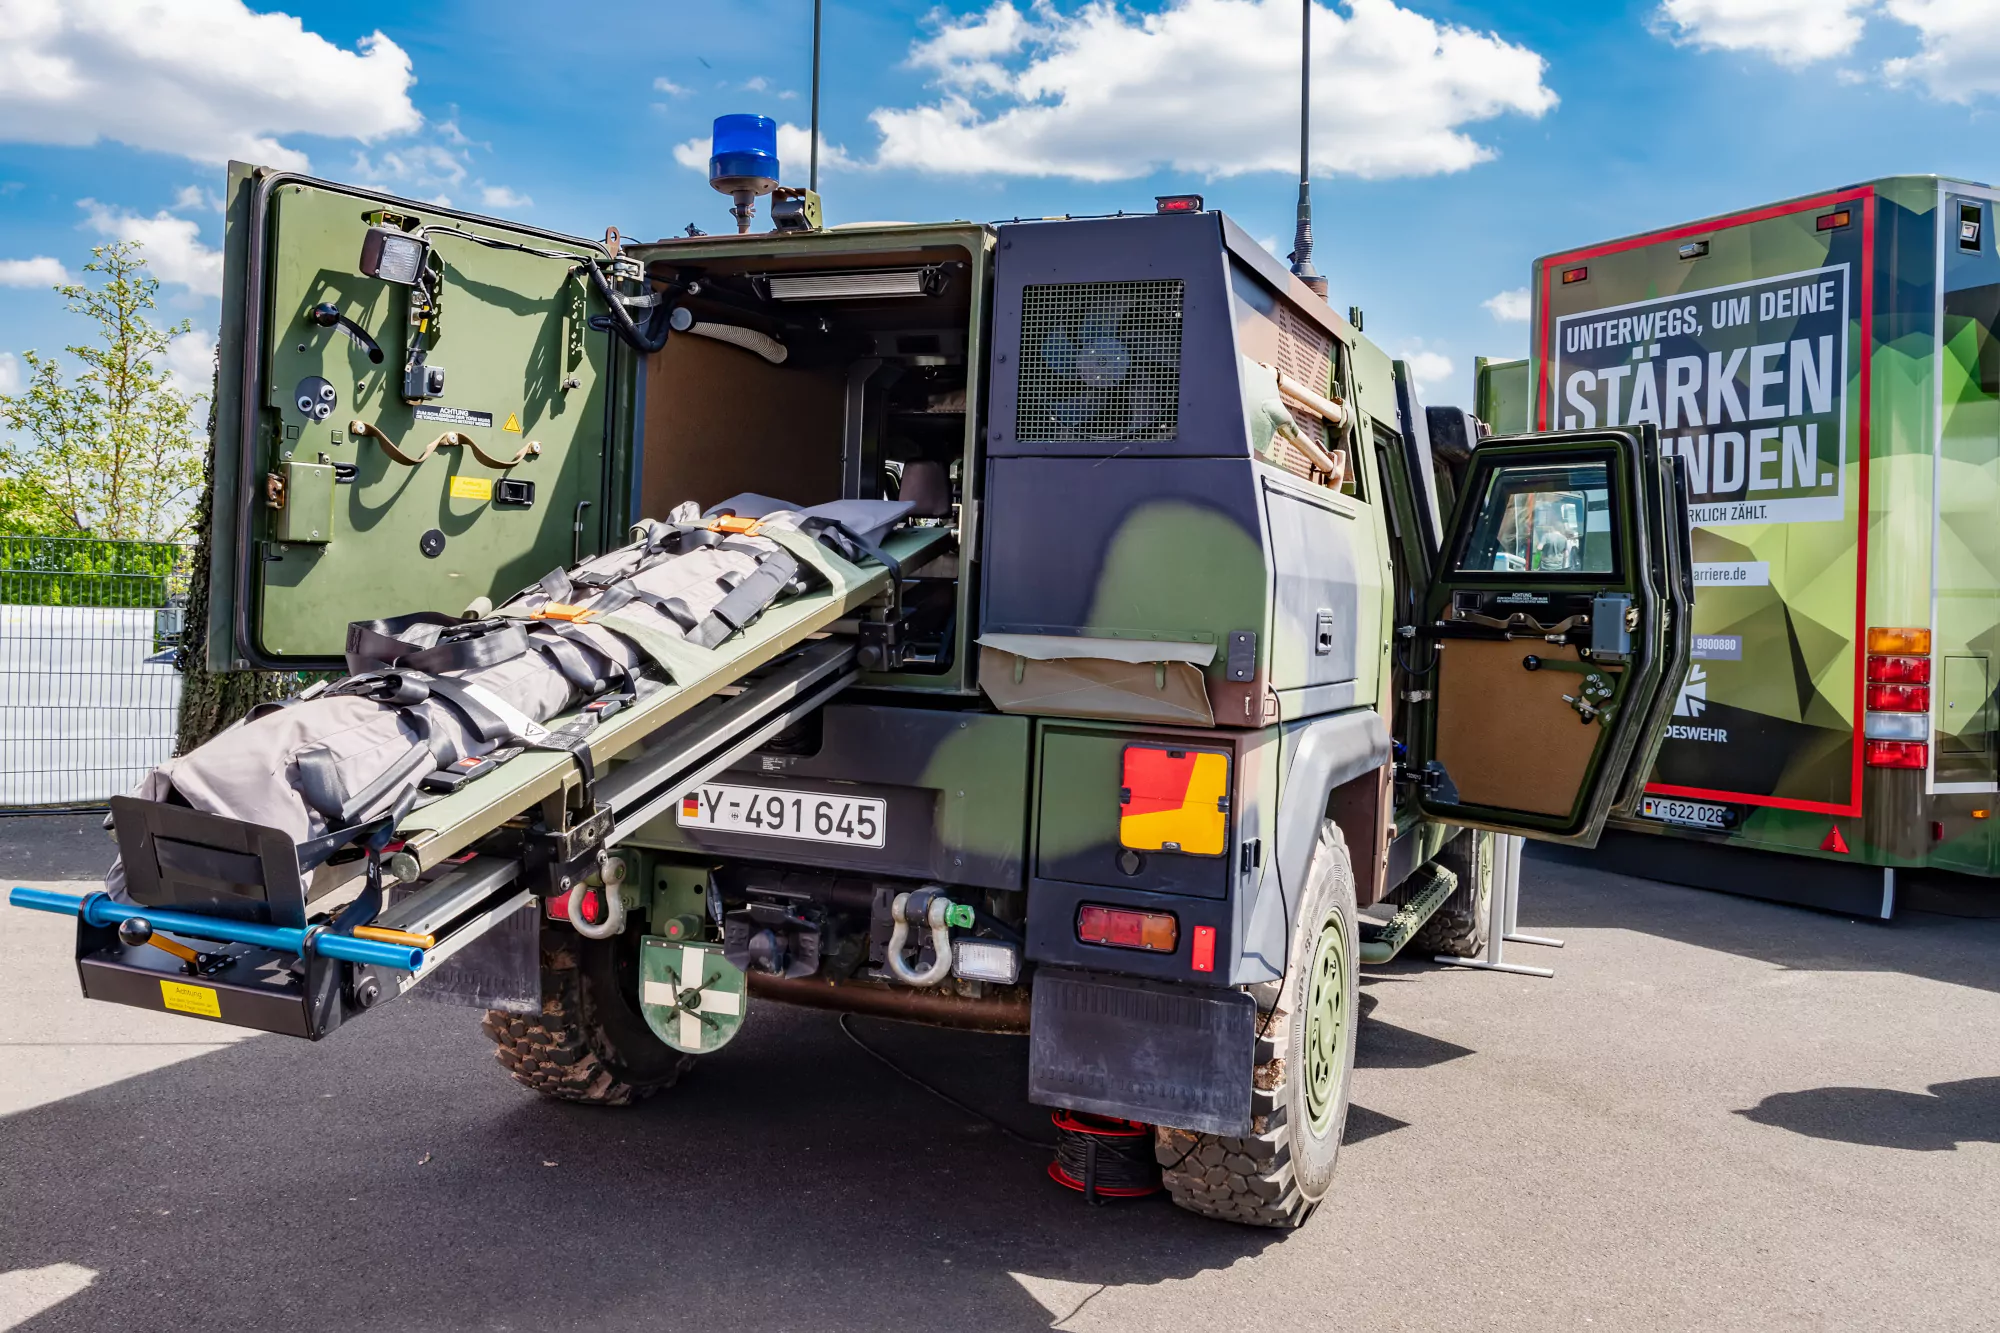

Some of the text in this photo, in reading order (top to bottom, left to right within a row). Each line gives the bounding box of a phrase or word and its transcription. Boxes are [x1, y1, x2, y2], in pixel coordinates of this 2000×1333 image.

[1566, 280, 1835, 353] UNTERWEGS, UM DEINE
[1564, 334, 1834, 430] STÄRKEN
[439, 407, 469, 416] ACHTUNG
[1731, 503, 1767, 520] ZÄHLT.
[1697, 638, 1736, 651] 9800880
[175, 986, 203, 1000] Achtung
